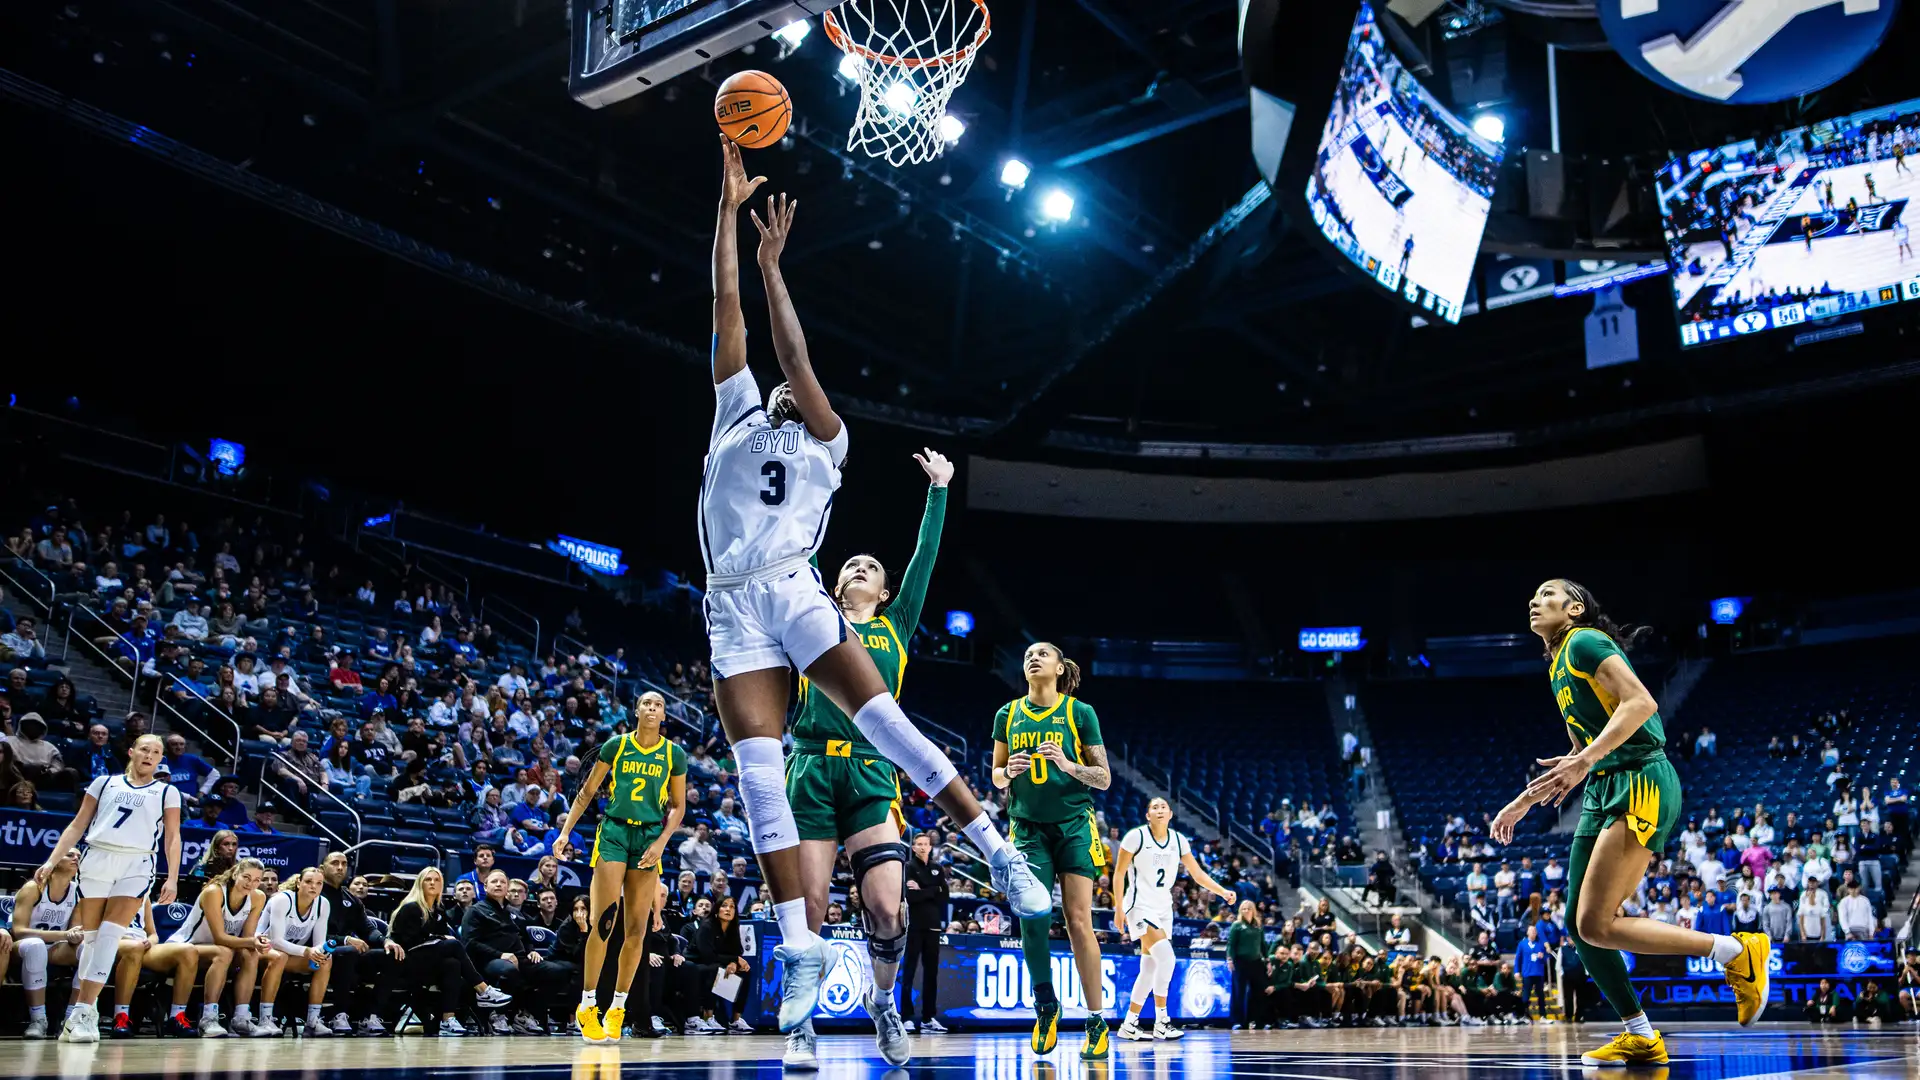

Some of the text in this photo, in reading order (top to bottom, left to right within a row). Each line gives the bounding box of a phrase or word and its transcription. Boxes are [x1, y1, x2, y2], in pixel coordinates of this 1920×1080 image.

[717, 99, 752, 118] ELITE
[751, 430, 800, 455] BYU
[760, 460, 786, 506] 3
[576, 544, 618, 571] COUGS
[1301, 632, 1359, 648] GO COUGS
[1012, 731, 1064, 750] BAYLOR
[622, 761, 663, 778] BAYLOR
[1031, 752, 1048, 784] 0
[115, 791, 146, 807] BYU
[631, 777, 646, 802] 2
[113, 806, 133, 829] 7
[0, 819, 61, 848] tive
[181, 838, 278, 867] pte pest
[1156, 868, 1166, 887] 2
[42, 909, 66, 923] BYU
[976, 953, 1018, 1008] GO
